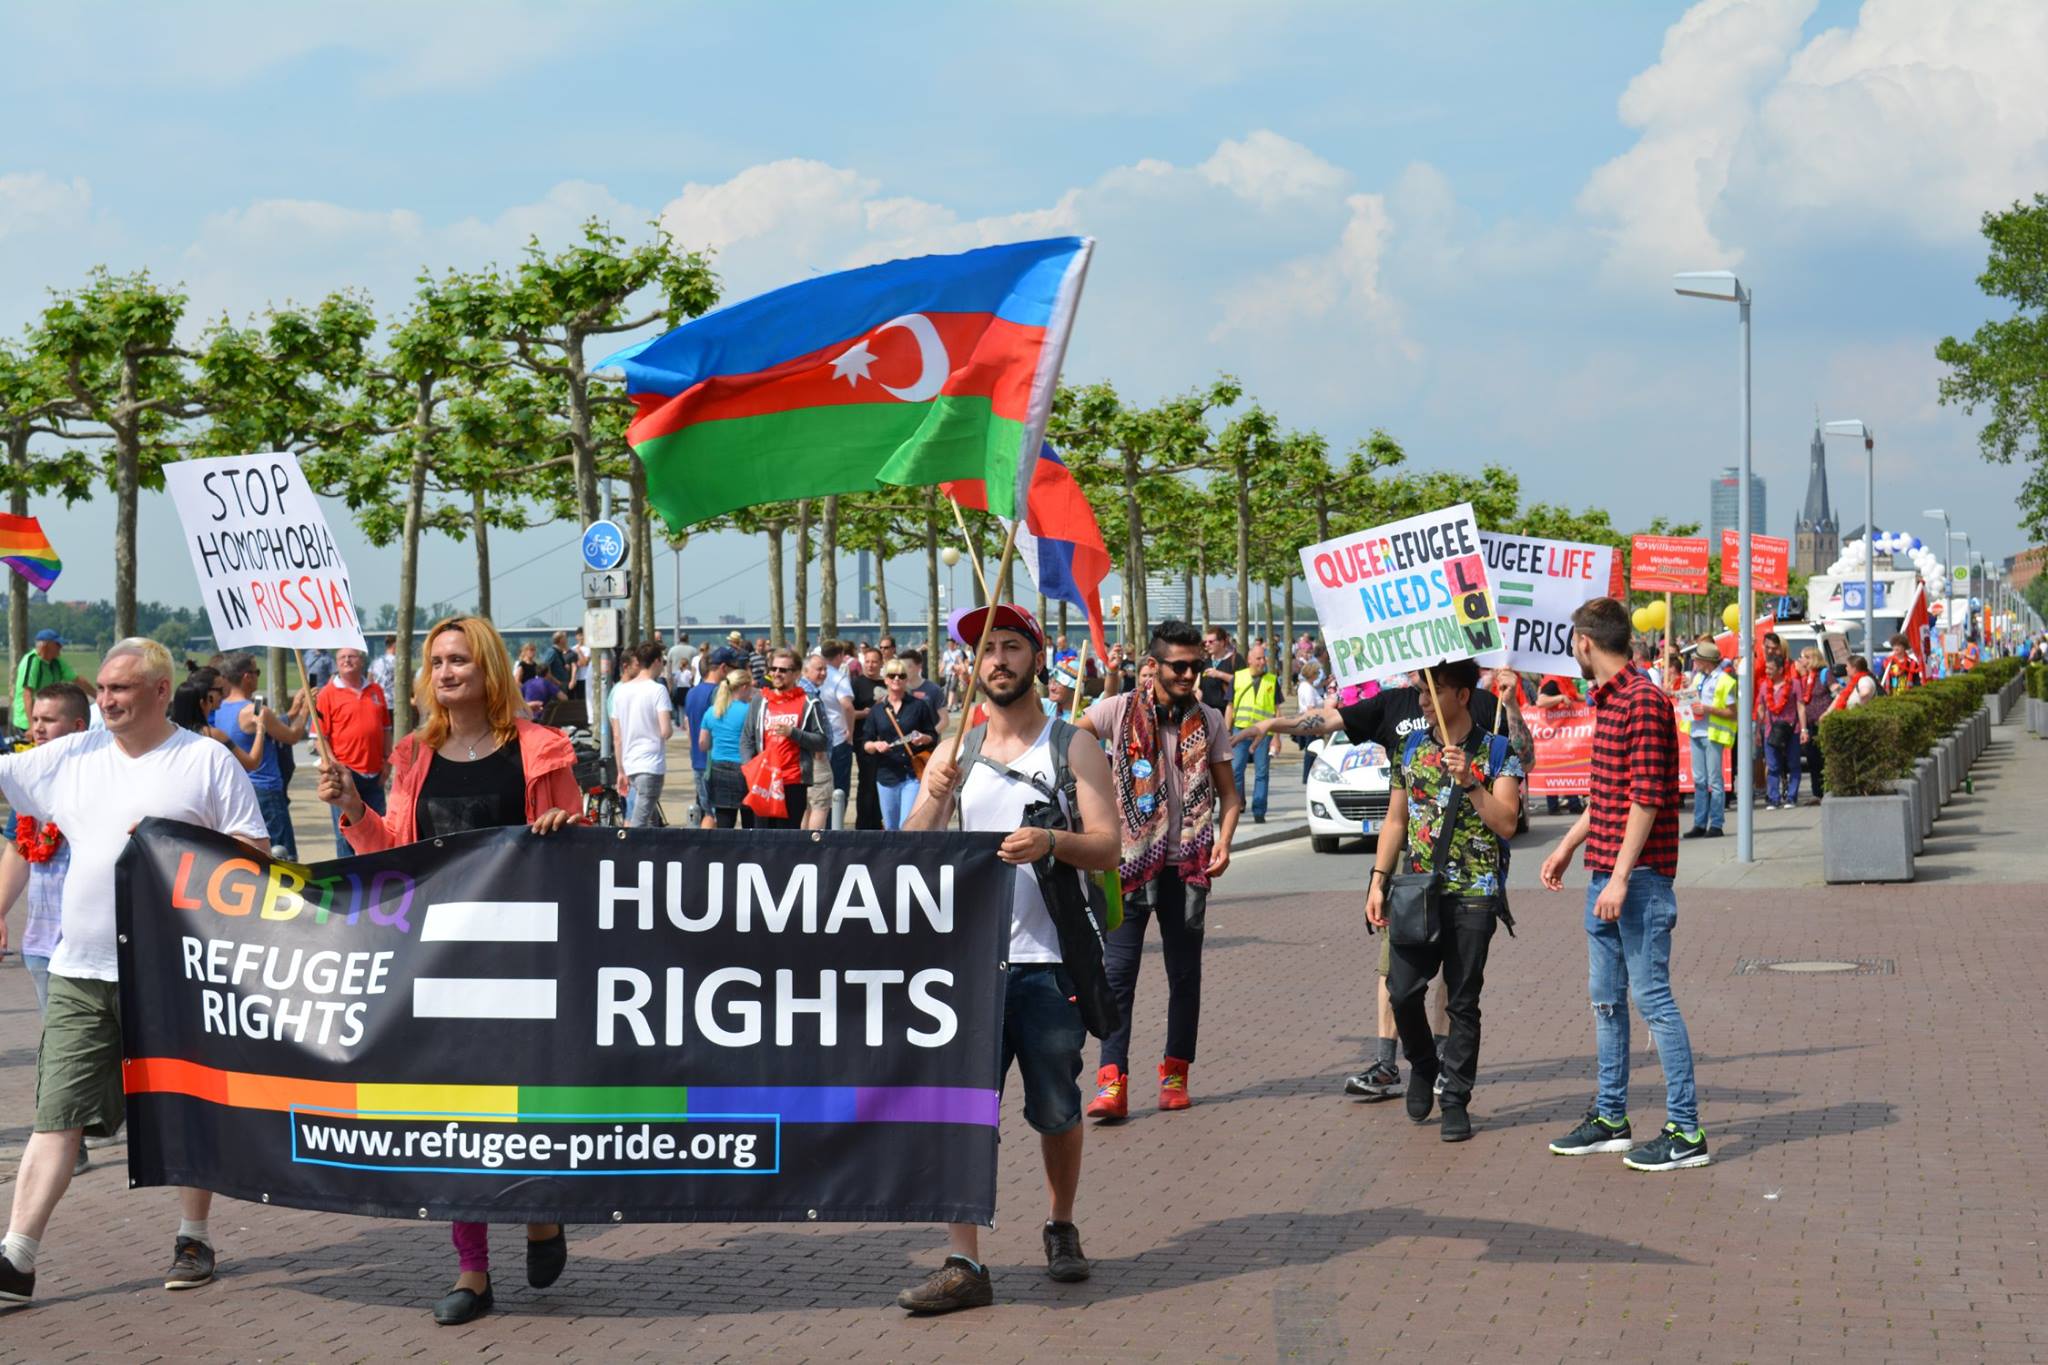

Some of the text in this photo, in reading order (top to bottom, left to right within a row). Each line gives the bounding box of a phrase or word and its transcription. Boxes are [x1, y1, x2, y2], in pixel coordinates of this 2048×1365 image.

[203, 464, 289, 521] STOP
[197, 523, 342, 578] HOMOPHOBIA
[1313, 518, 1475, 589] QUEEREFUGEE
[1547, 546, 1596, 580] LIFE
[1648, 542, 1707, 554] Willkommen!
[217, 586, 251, 631] IN
[1360, 569, 1452, 623] NEEDS
[1332, 614, 1465, 677] PROTECTION
[1513, 617, 1575, 658] PRIS
[172, 851, 416, 933] LGBTIQ
[598, 859, 955, 934] HUMAN
[182, 935, 395, 996] REFUGEE
[202, 989, 368, 1047] RIGHTS
[596, 966, 959, 1048] RIGHTS
[301, 1122, 757, 1168] www.refugee-pride.org
